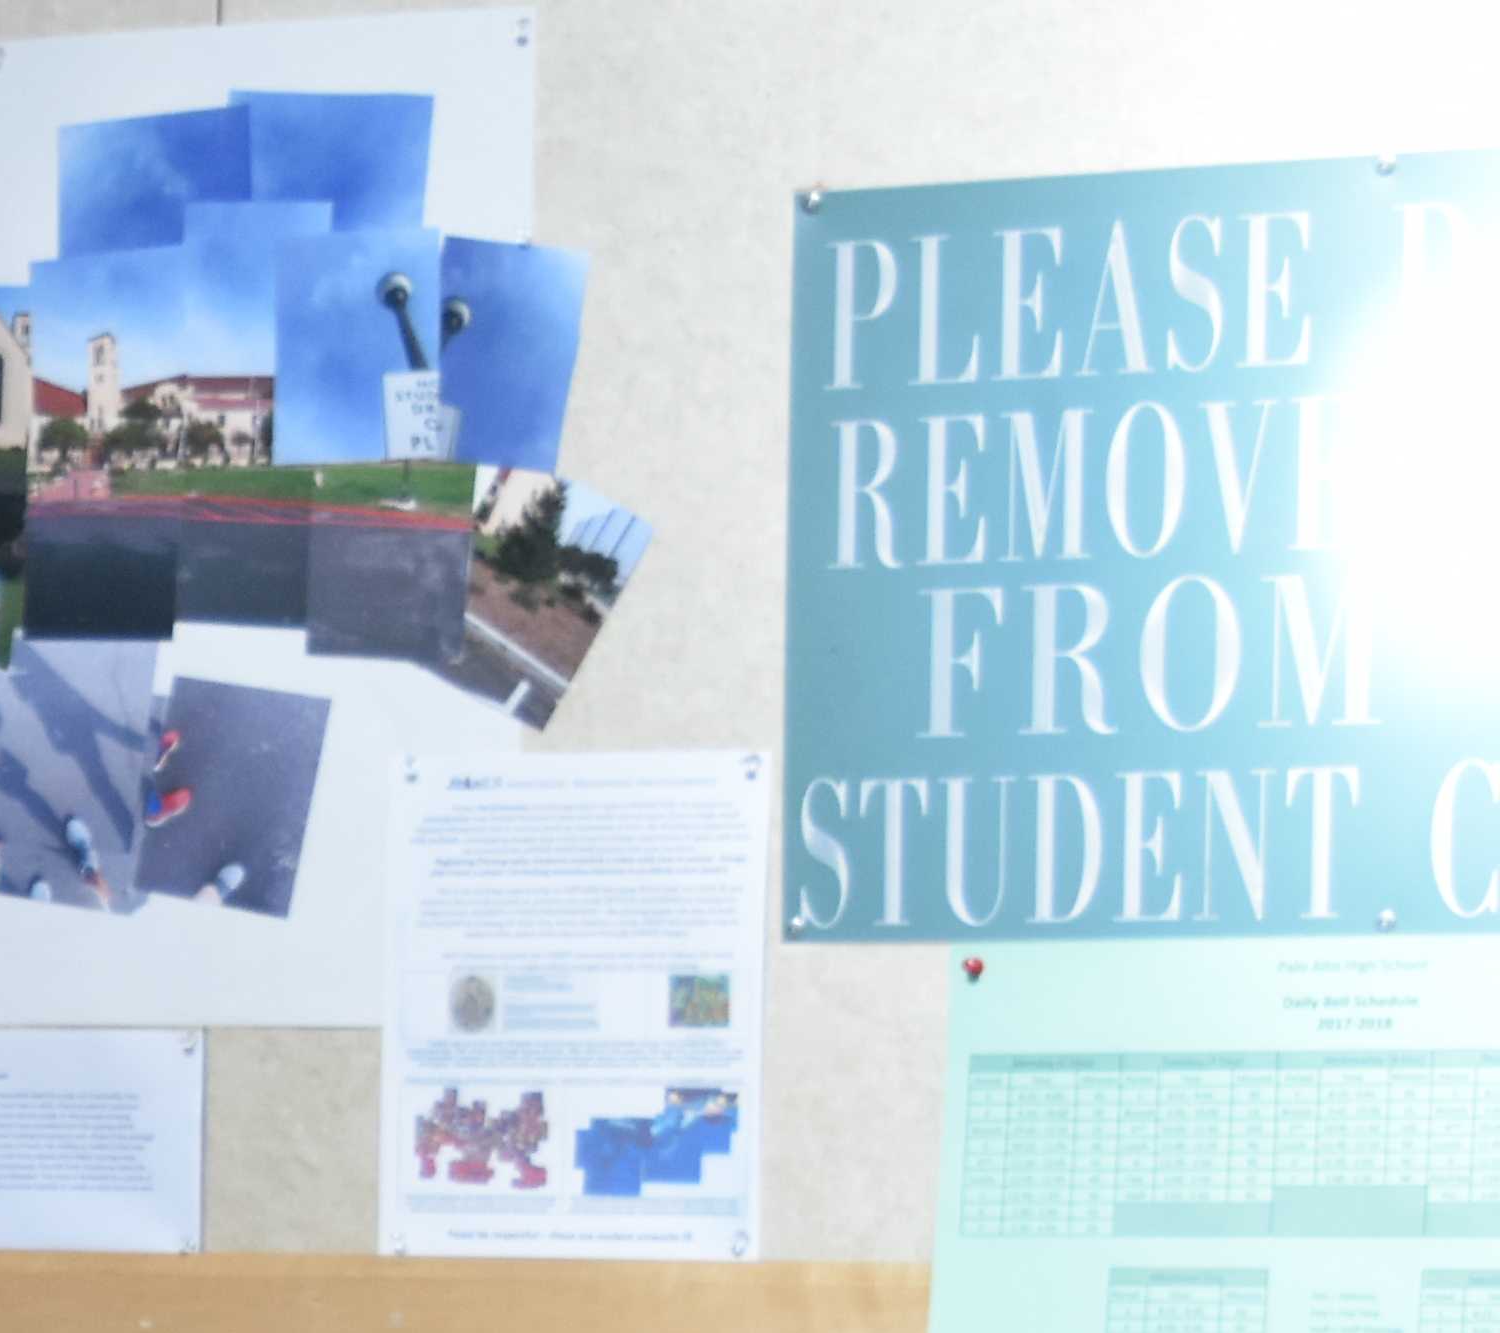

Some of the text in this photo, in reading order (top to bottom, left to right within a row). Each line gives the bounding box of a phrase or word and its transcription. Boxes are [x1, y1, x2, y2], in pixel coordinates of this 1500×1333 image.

[824, 211, 1312, 390] PLEASE
[915, 573, 1382, 738] FROM
[799, 765, 1360, 929] STUDENT
